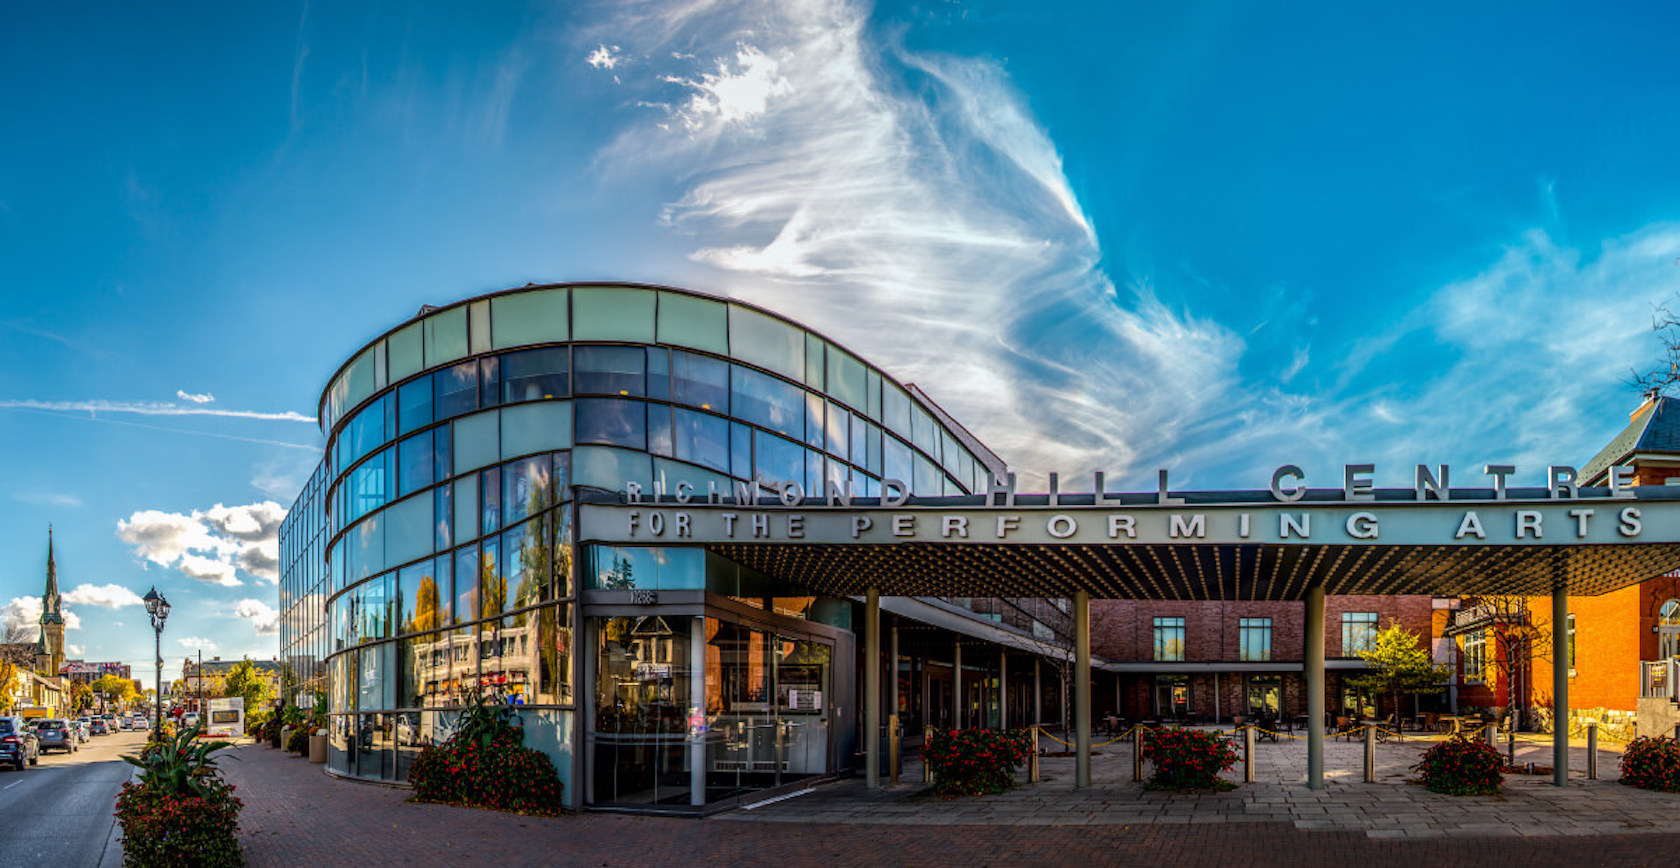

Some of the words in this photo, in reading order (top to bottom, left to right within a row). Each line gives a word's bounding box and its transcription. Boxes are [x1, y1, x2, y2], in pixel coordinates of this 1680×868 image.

[626, 480, 909, 507] RICHMOND
[986, 469, 1185, 506] HILL
[1271, 464, 1635, 502] CENTRE
[629, 511, 691, 537] FOR
[722, 513, 805, 539] THE
[851, 512, 1379, 539] PERFORMING
[1455, 507, 1642, 538] ARTS
